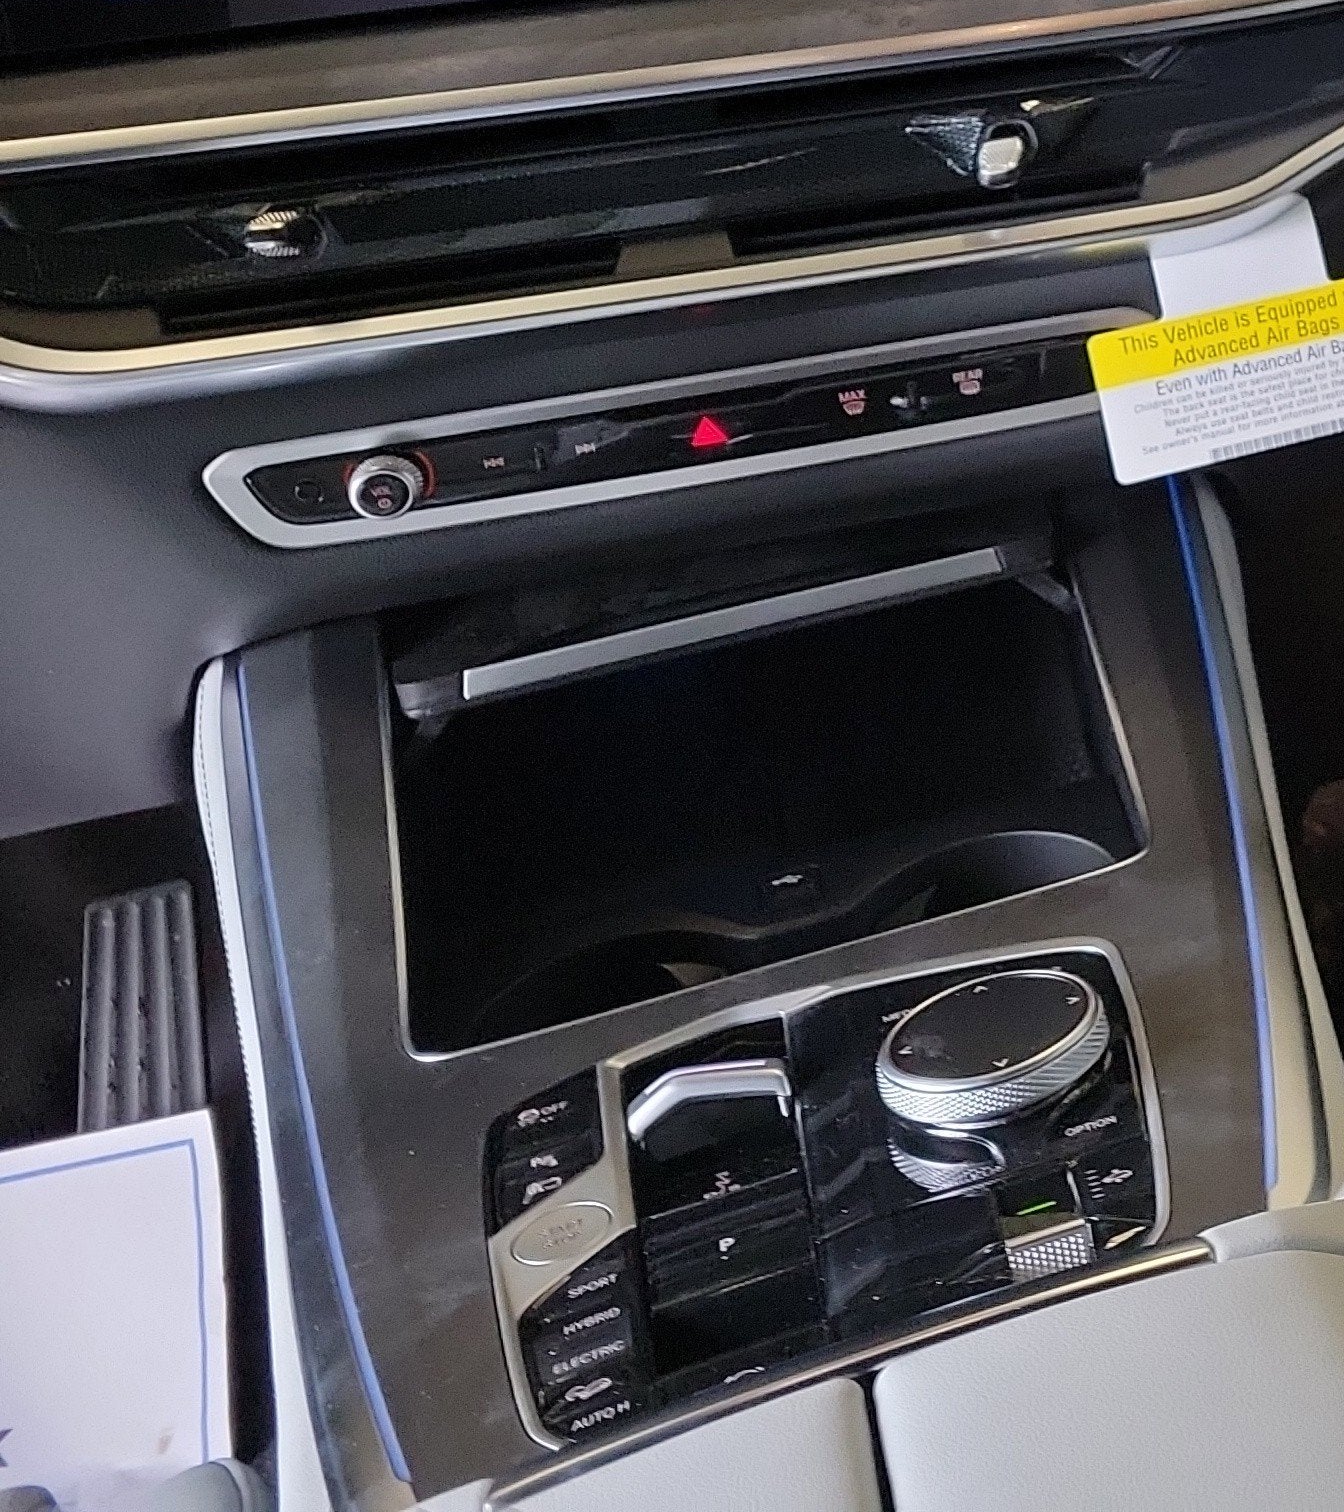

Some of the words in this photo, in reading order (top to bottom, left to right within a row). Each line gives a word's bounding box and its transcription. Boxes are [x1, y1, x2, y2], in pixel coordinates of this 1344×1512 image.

[1118, 332, 1159, 355] This
[1162, 316, 1229, 344] Vehicle
[1234, 311, 1251, 329] is
[1255, 289, 1338, 324] Equipped
[1173, 330, 1260, 367] Advanced
[1267, 326, 1291, 346] Air
[1296, 316, 1341, 338] Bags
[1155, 376, 1192, 397] Even
[1194, 366, 1228, 386] with
[1232, 348, 1303, 378] Advanced
[1307, 345, 1328, 362] Air
[1064, 1115, 1118, 1137] OPTION
[718, 1237, 736, 1252] P
[567, 1272, 619, 1299] SPORT
[562, 1306, 621, 1336] HYBRID
[551, 1339, 626, 1375] ELECTRIC
[570, 1406, 616, 1433] AUTO
[616, 1399, 631, 1414] H
